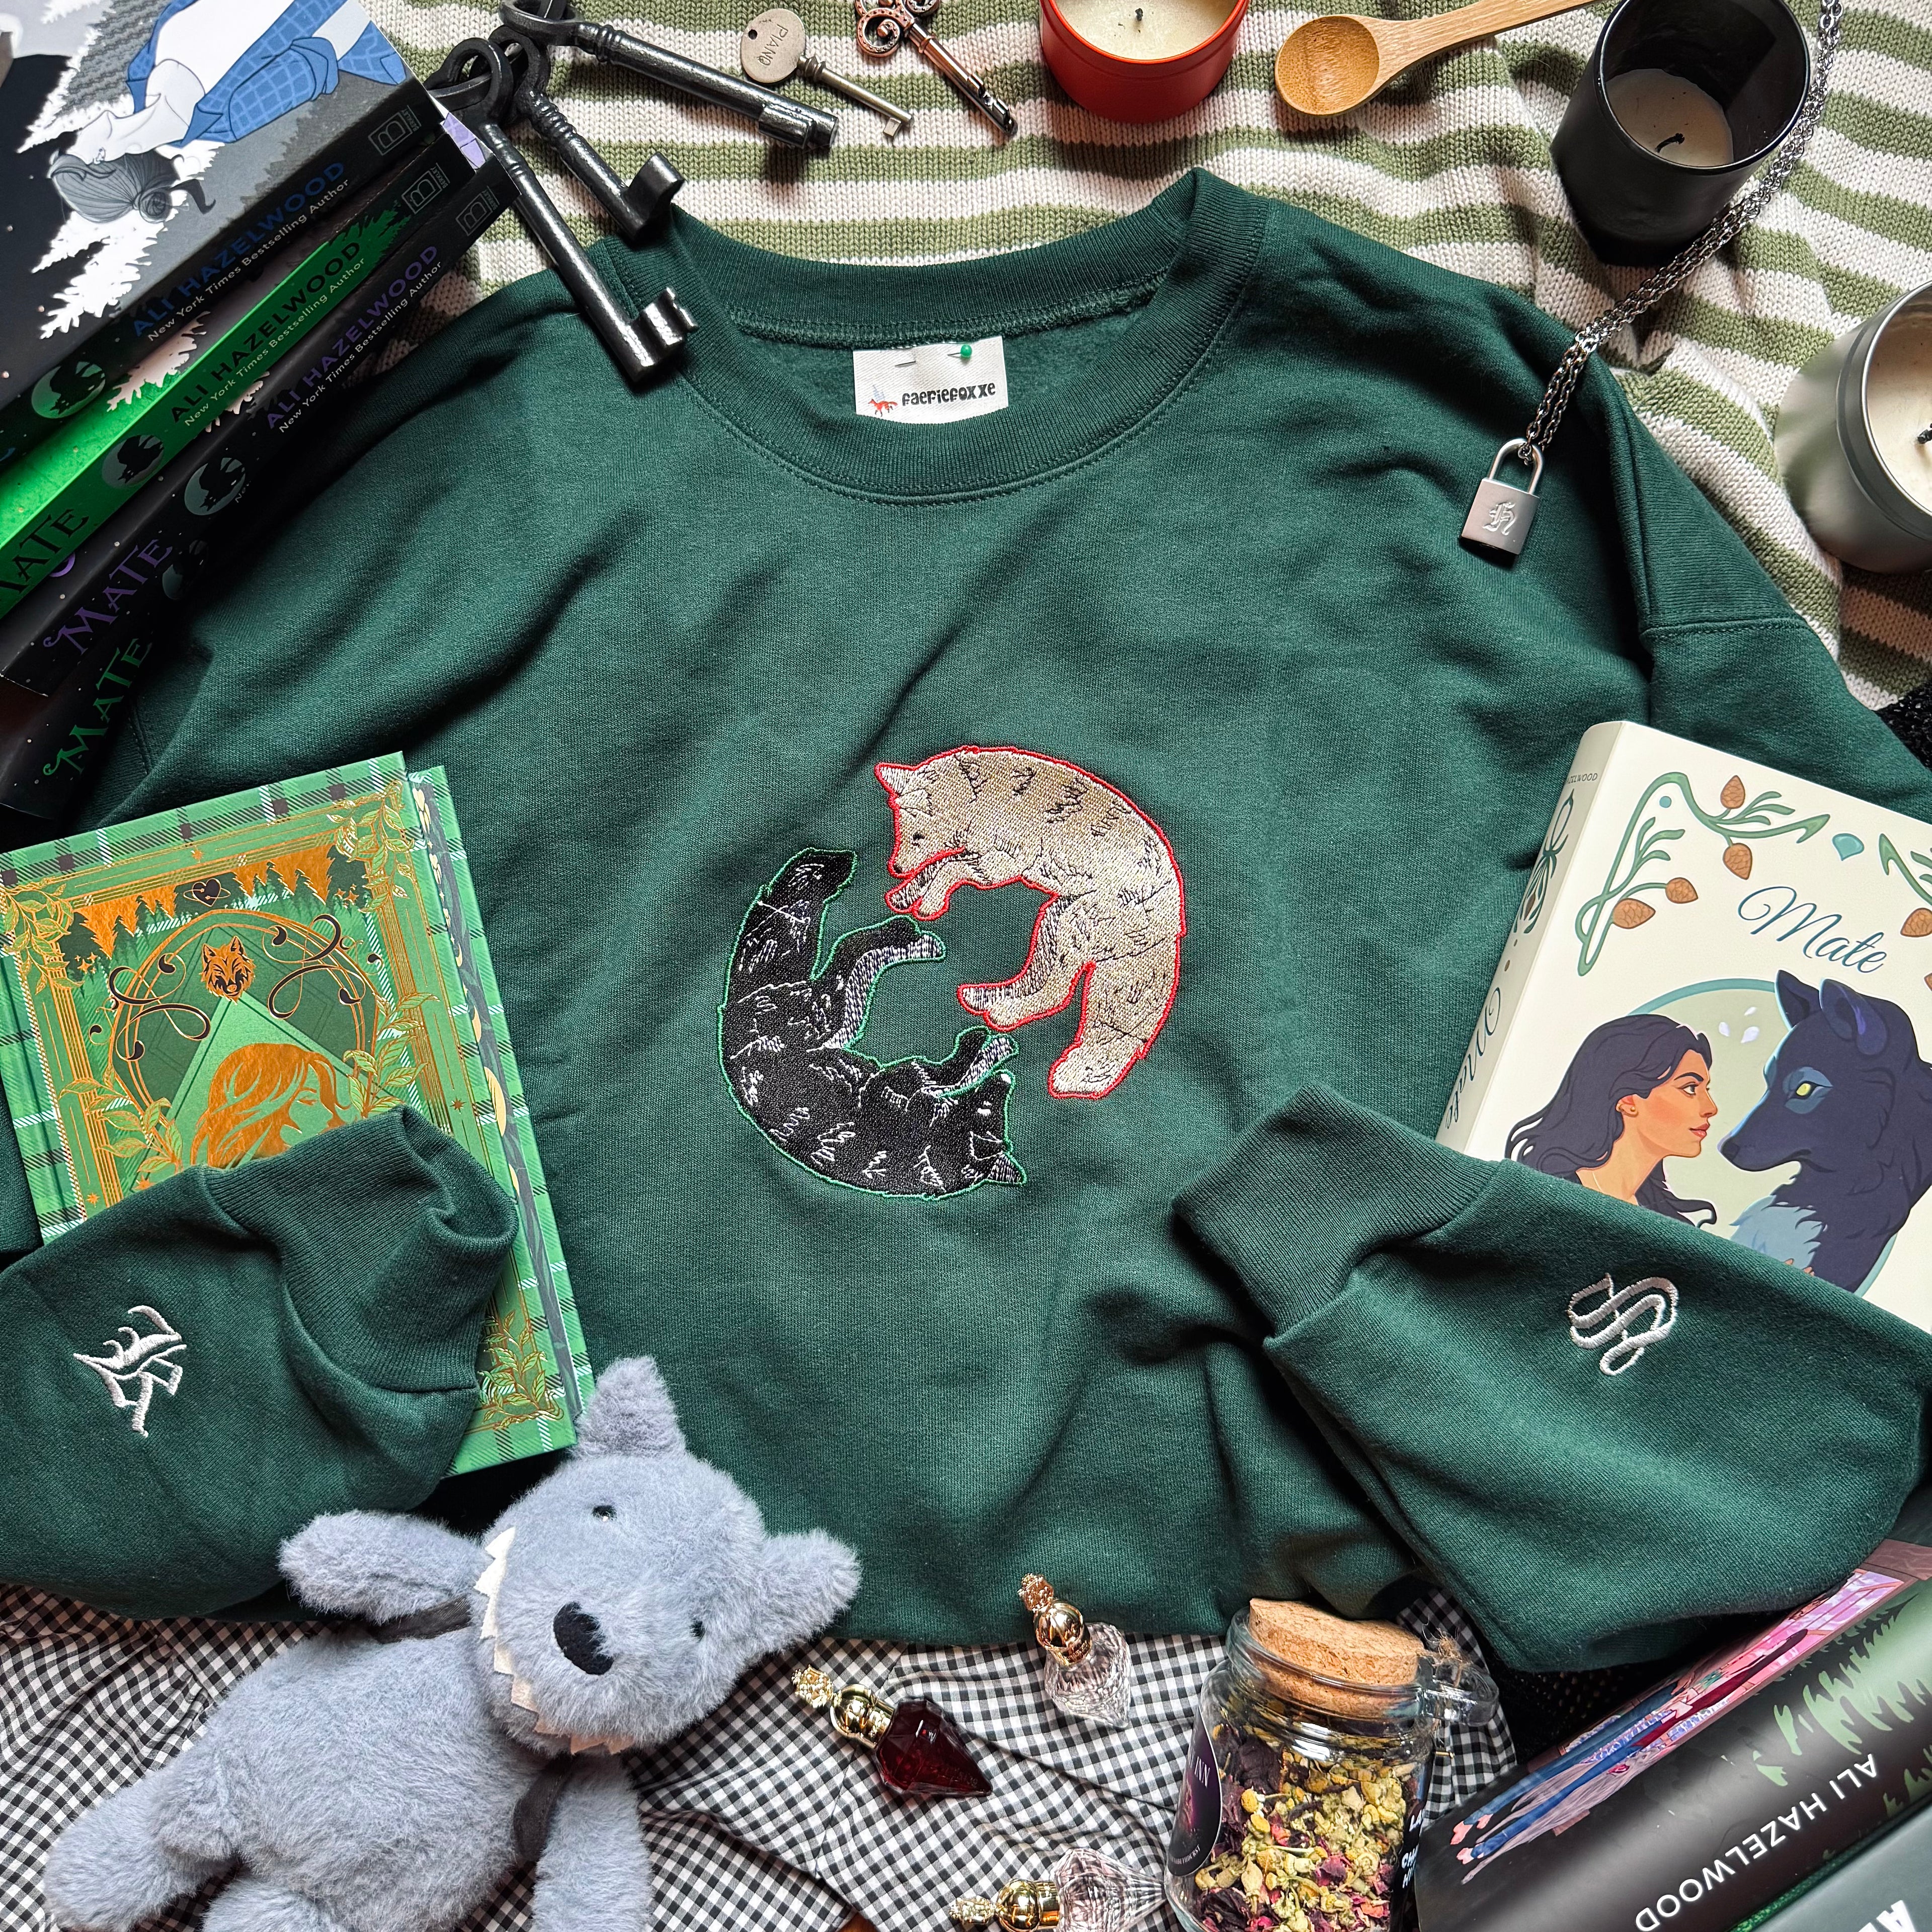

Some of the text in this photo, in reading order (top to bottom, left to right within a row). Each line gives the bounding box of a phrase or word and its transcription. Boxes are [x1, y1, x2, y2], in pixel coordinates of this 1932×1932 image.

[757, 24, 788, 66] PIANO
[133, 162, 344, 337] ALI HAZELWOOD
[430, 166, 448, 189] BERKLEY
[147, 179, 350, 342] New York Times Bestselling Author
[172, 242, 360, 423] ALI HAZELWOOD
[184, 258, 365, 426] New York Times Bestselling Author
[267, 246, 437, 429] ALI HAZELWOOD
[278, 261, 442, 433] New York Times Bestselling Author
[43, 539, 173, 656] MATE
[43, 638, 153, 776] MATE
[1738, 886, 1887, 973] Mate
[1565, 1272, 1679, 1376] S
[1635, 1753, 1878, 1931] ALI HAZELWOOD
